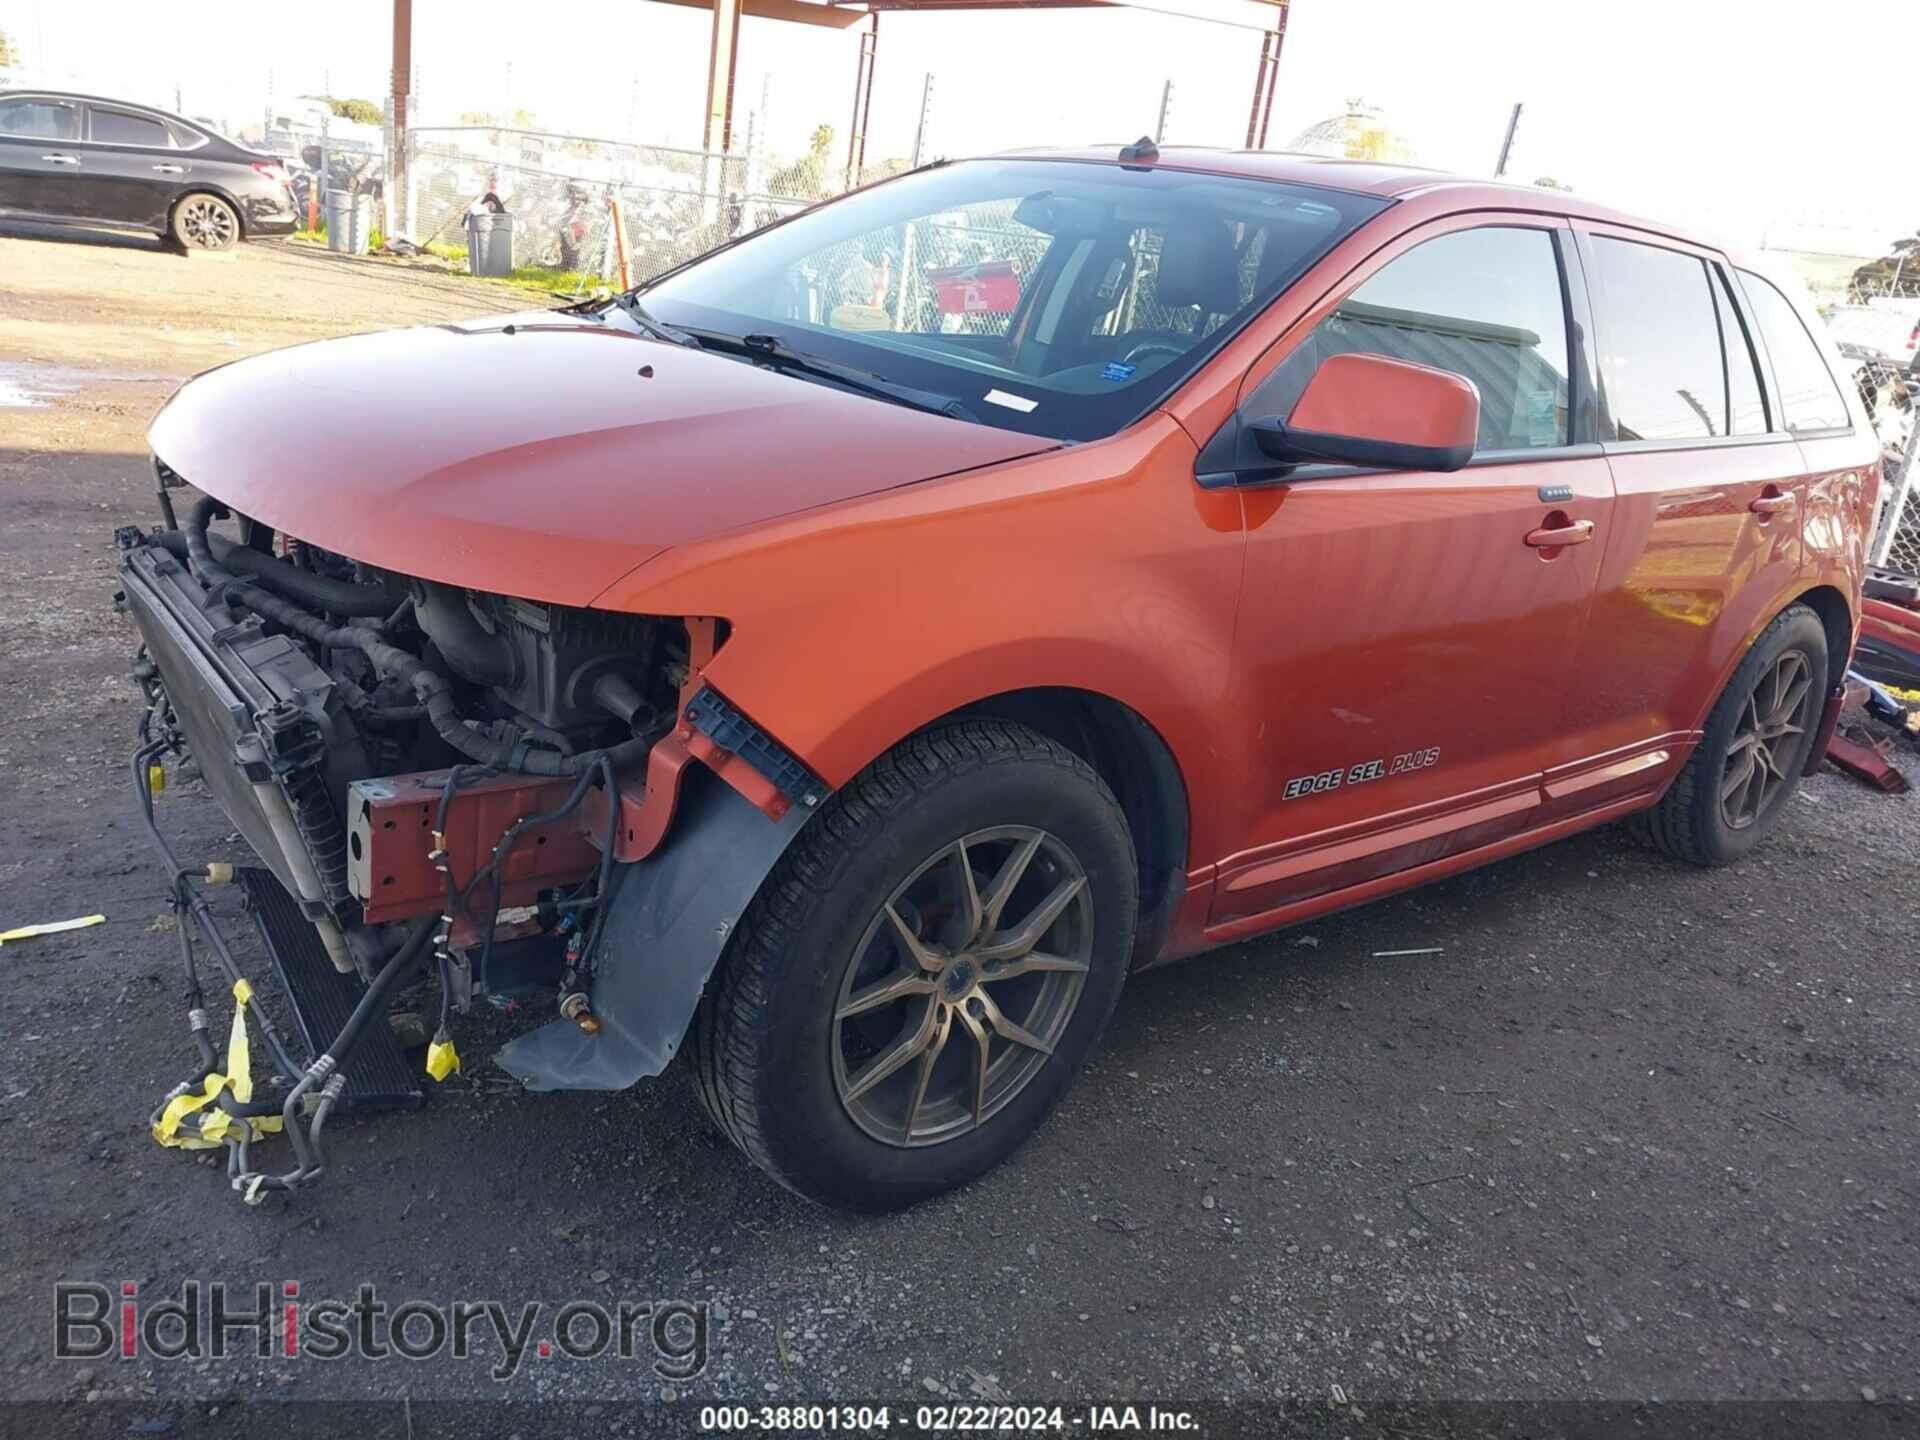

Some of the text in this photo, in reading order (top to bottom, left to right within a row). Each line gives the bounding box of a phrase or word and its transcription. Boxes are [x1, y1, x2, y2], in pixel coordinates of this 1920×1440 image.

[1282, 747, 1440, 800] EDGE SEL PLUS
